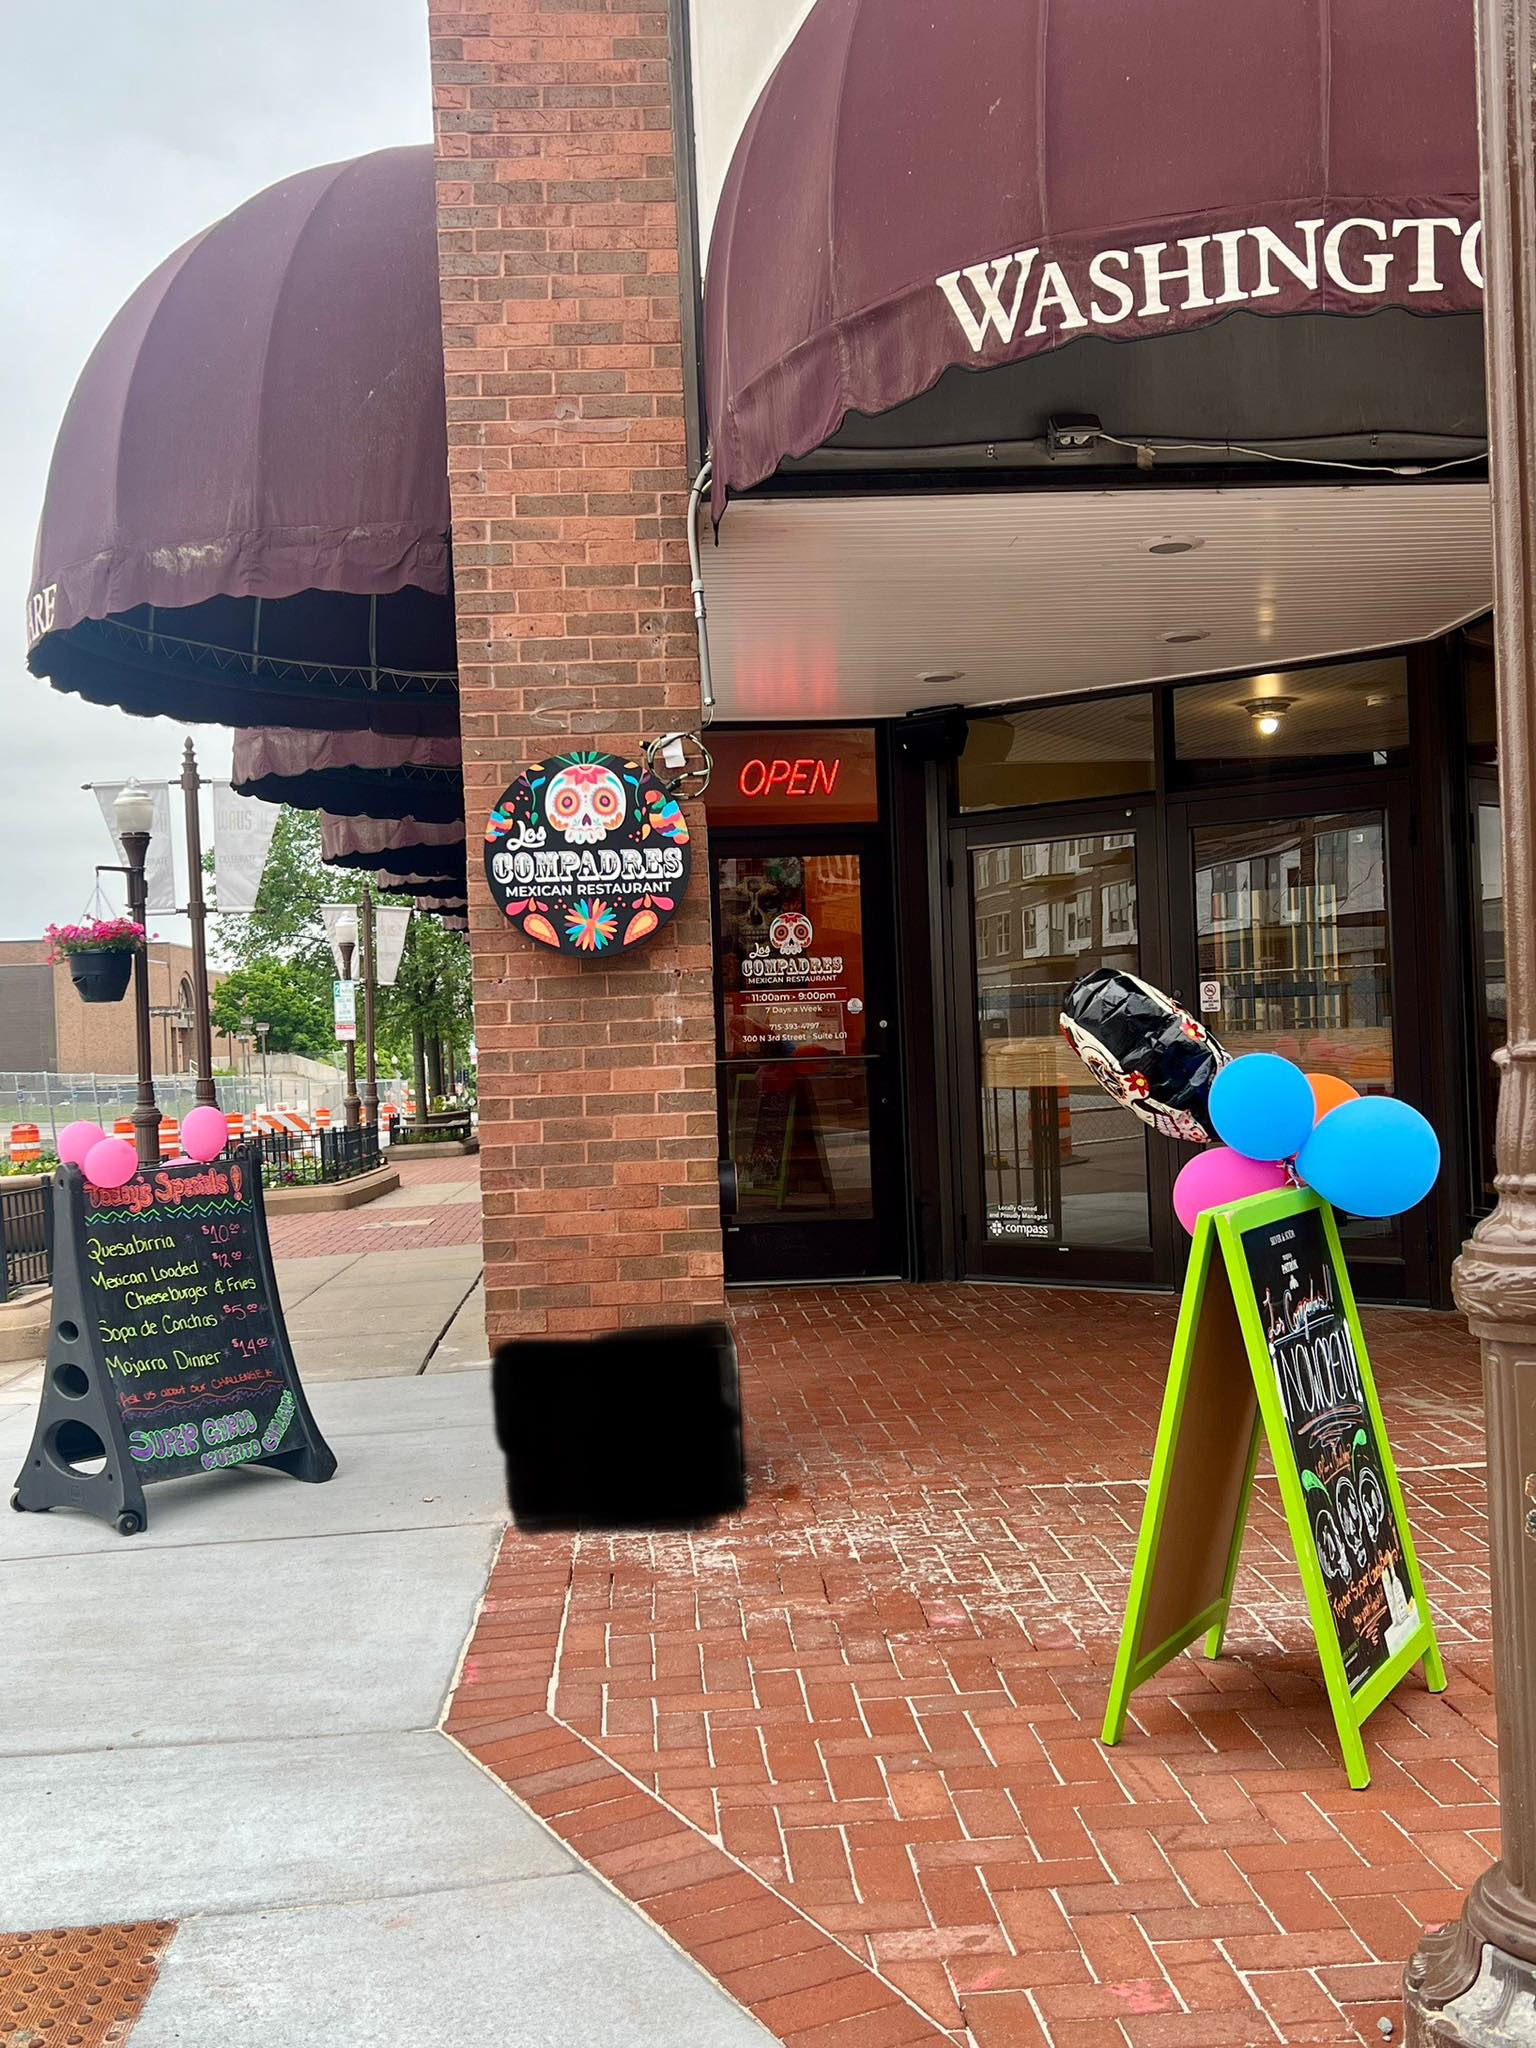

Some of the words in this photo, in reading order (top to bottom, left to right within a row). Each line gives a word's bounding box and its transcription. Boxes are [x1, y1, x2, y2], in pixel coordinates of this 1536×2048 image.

[740, 758, 840, 797] OPEN
[506, 820, 547, 851] Los
[492, 847, 684, 884] COMPADRES
[505, 884, 573, 898] MEXICAN
[577, 881, 672, 896] RESTAURANT
[748, 942, 771, 959] Los
[742, 957, 843, 977] COMPADRES
[748, 976, 784, 985] MEXICAN
[786, 974, 837, 983] RESTAURANT
[751, 993, 790, 1002] 11:00am
[798, 991, 836, 1002] 9:00pm
[772, 1006, 792, 1015] Days
[742, 1035, 758, 1043] 300
[782, 1033, 806, 1041] Street
[813, 1032, 833, 1040] Suite
[835, 1031, 848, 1039] L01
[769, 1022, 820, 1031] 715-393-4797
[84, 1176, 153, 1213] Today's
[1000, 1212, 1021, 1220] Proudly
[1021, 1212, 1048, 1221] Managed
[1005, 1224, 1049, 1237] compass
[87, 1234, 176, 1265] Quesabirria
[91, 1271, 148, 1290] Mexican
[151, 1260, 199, 1282] Loaded
[125, 1284, 208, 1310] Cheeseburger
[214, 1278, 225, 1295] &
[227, 1277, 257, 1291] Fries
[98, 1320, 138, 1344] Sopa
[140, 1319, 159, 1337] de
[162, 1313, 218, 1334] Conchas
[104, 1355, 168, 1378] Mojarra
[173, 1350, 222, 1370] Dinner
[118, 1392, 141, 1407] Ask
[144, 1391, 157, 1400] us
[160, 1385, 187, 1397] about
[190, 1383, 206, 1393] our
[211, 1369, 265, 1388] CHALLENGE
[129, 1422, 199, 1461] SUPER
